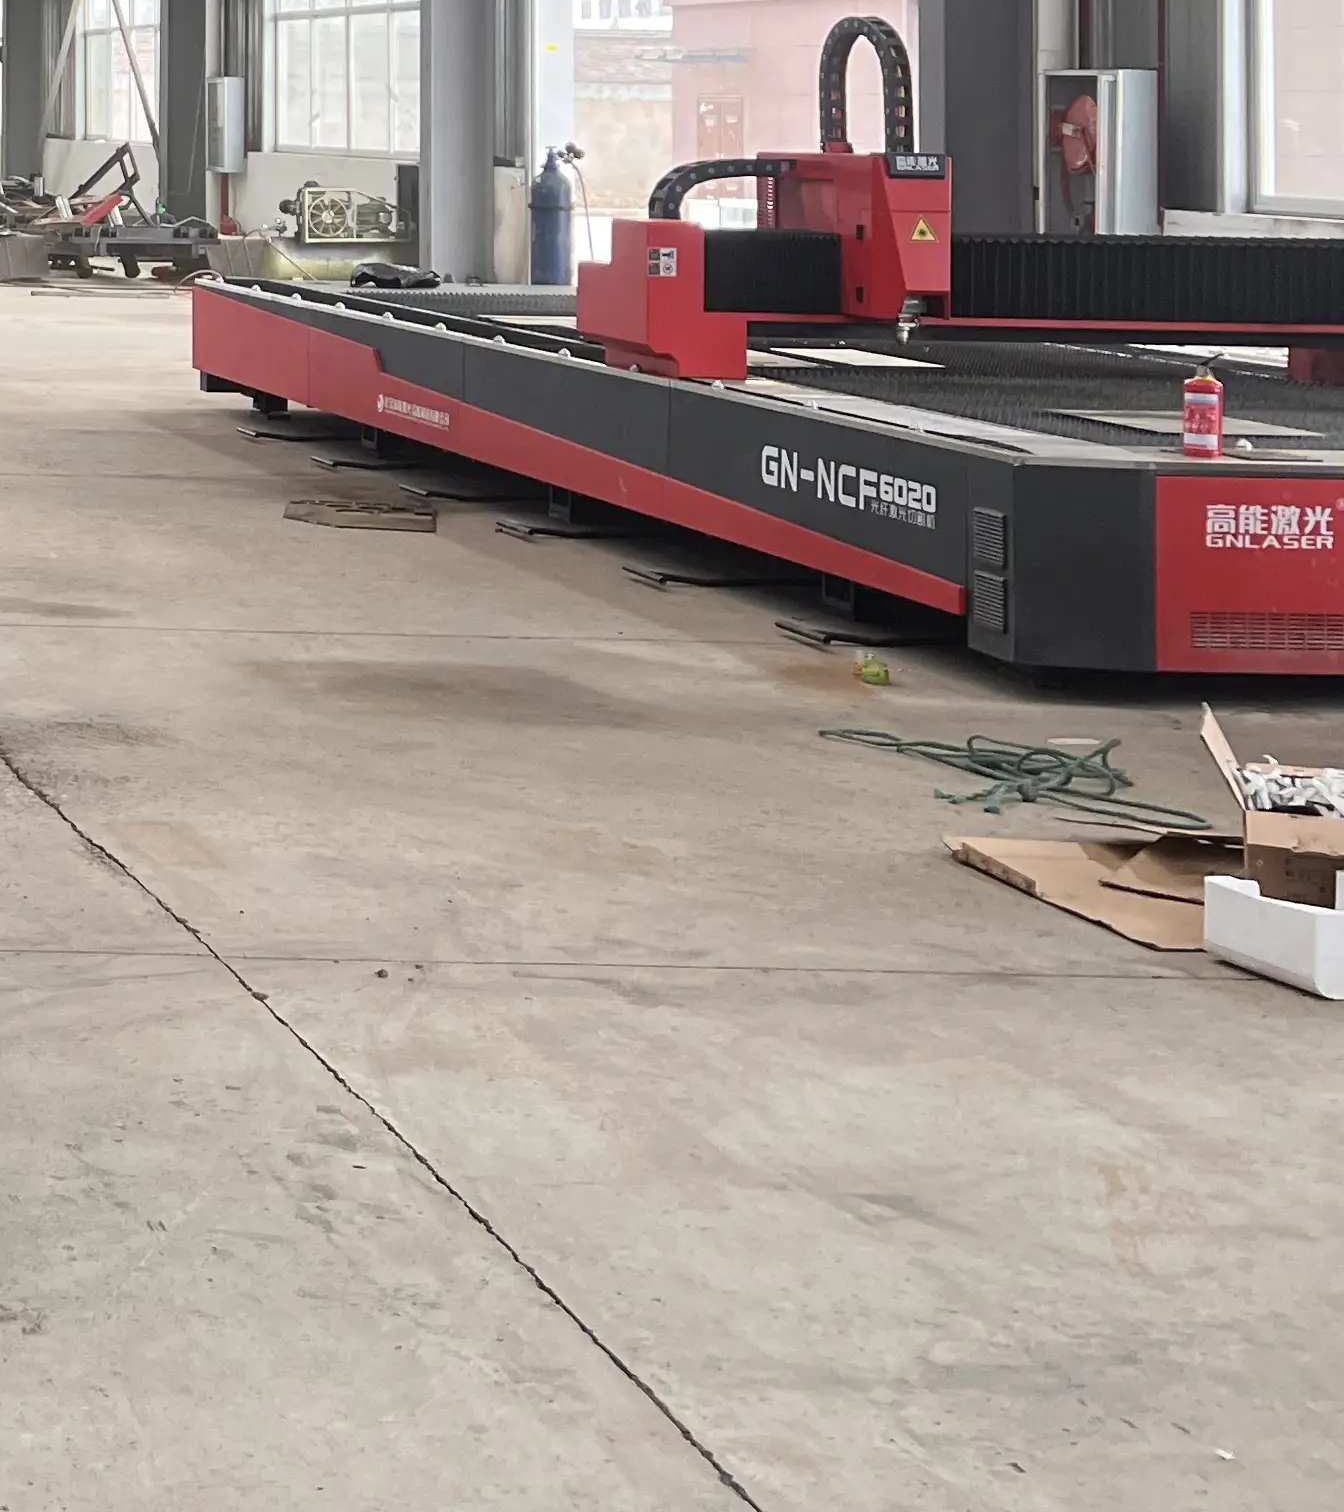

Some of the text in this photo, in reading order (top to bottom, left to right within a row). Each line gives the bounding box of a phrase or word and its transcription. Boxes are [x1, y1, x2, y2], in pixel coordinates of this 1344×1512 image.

[1205, 503, 1334, 535] 高能激光
[1205, 534, 1334, 549] GNLASER
